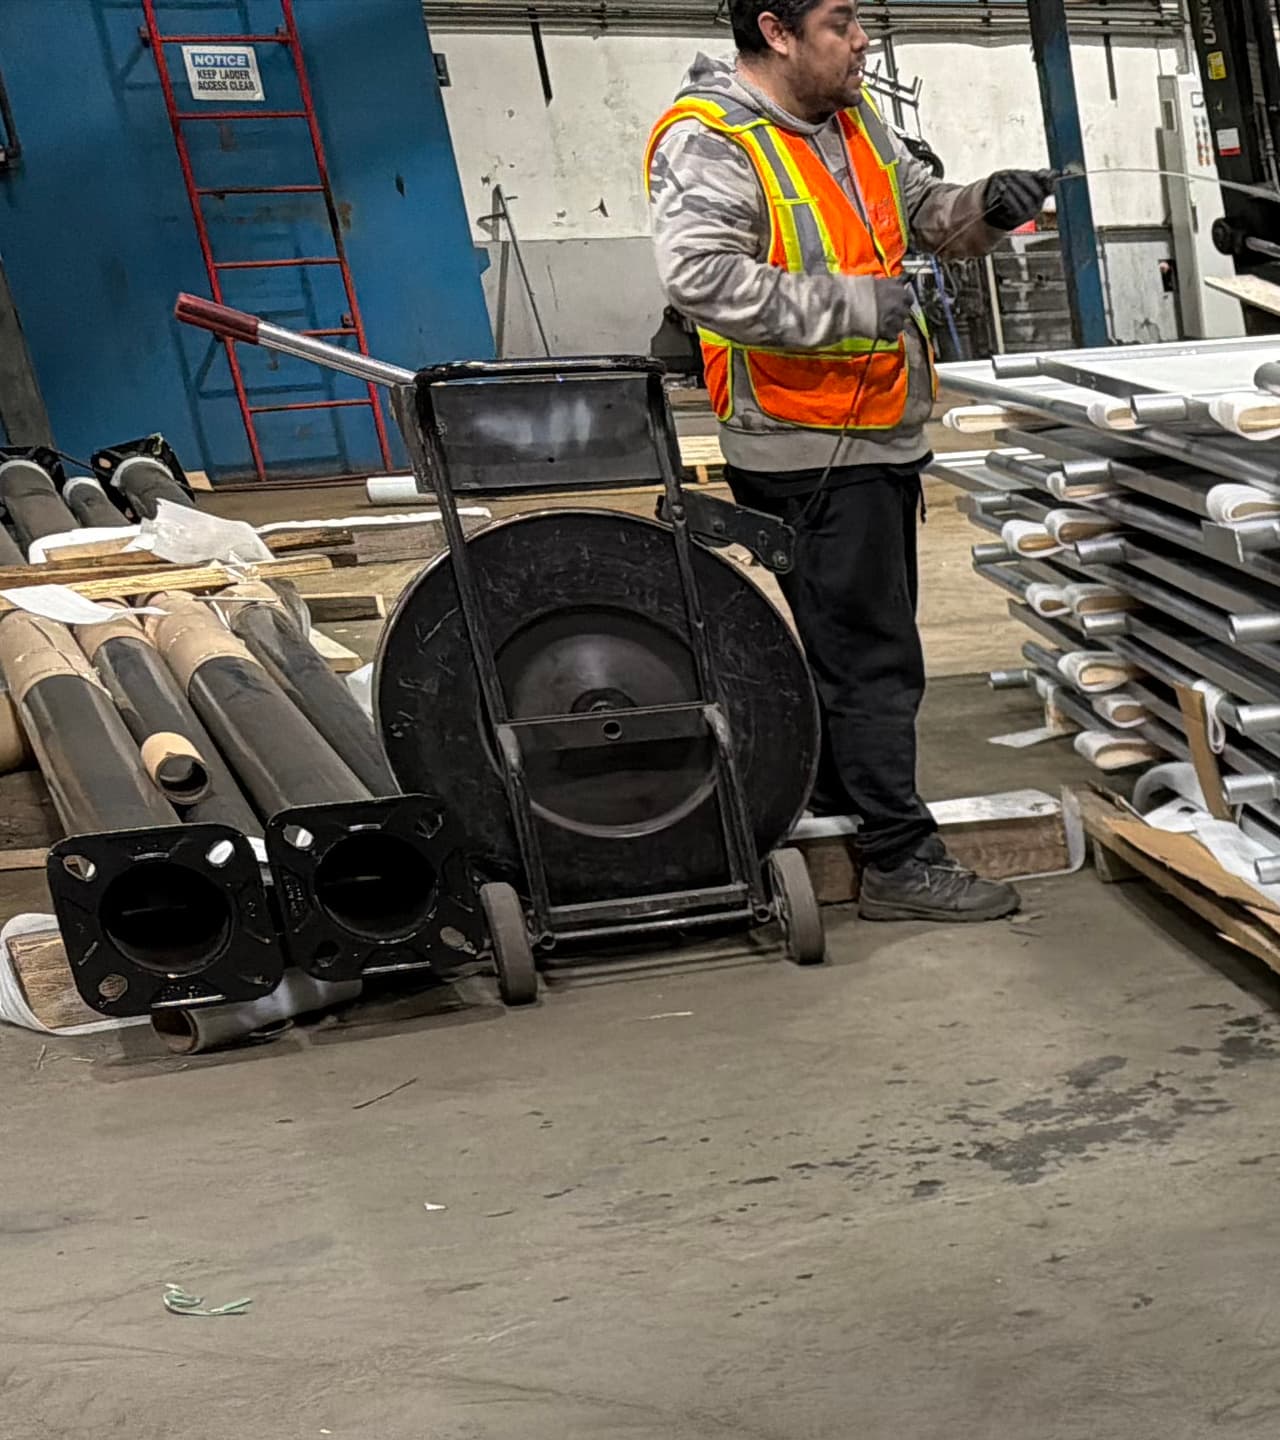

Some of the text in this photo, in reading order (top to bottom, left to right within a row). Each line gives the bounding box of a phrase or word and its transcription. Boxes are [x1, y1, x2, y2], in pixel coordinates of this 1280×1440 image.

[194, 54, 247, 66] NOTICE
[196, 69, 251, 80] KEEP LADDER
[198, 81, 256, 91] ACCESS CLEAR
